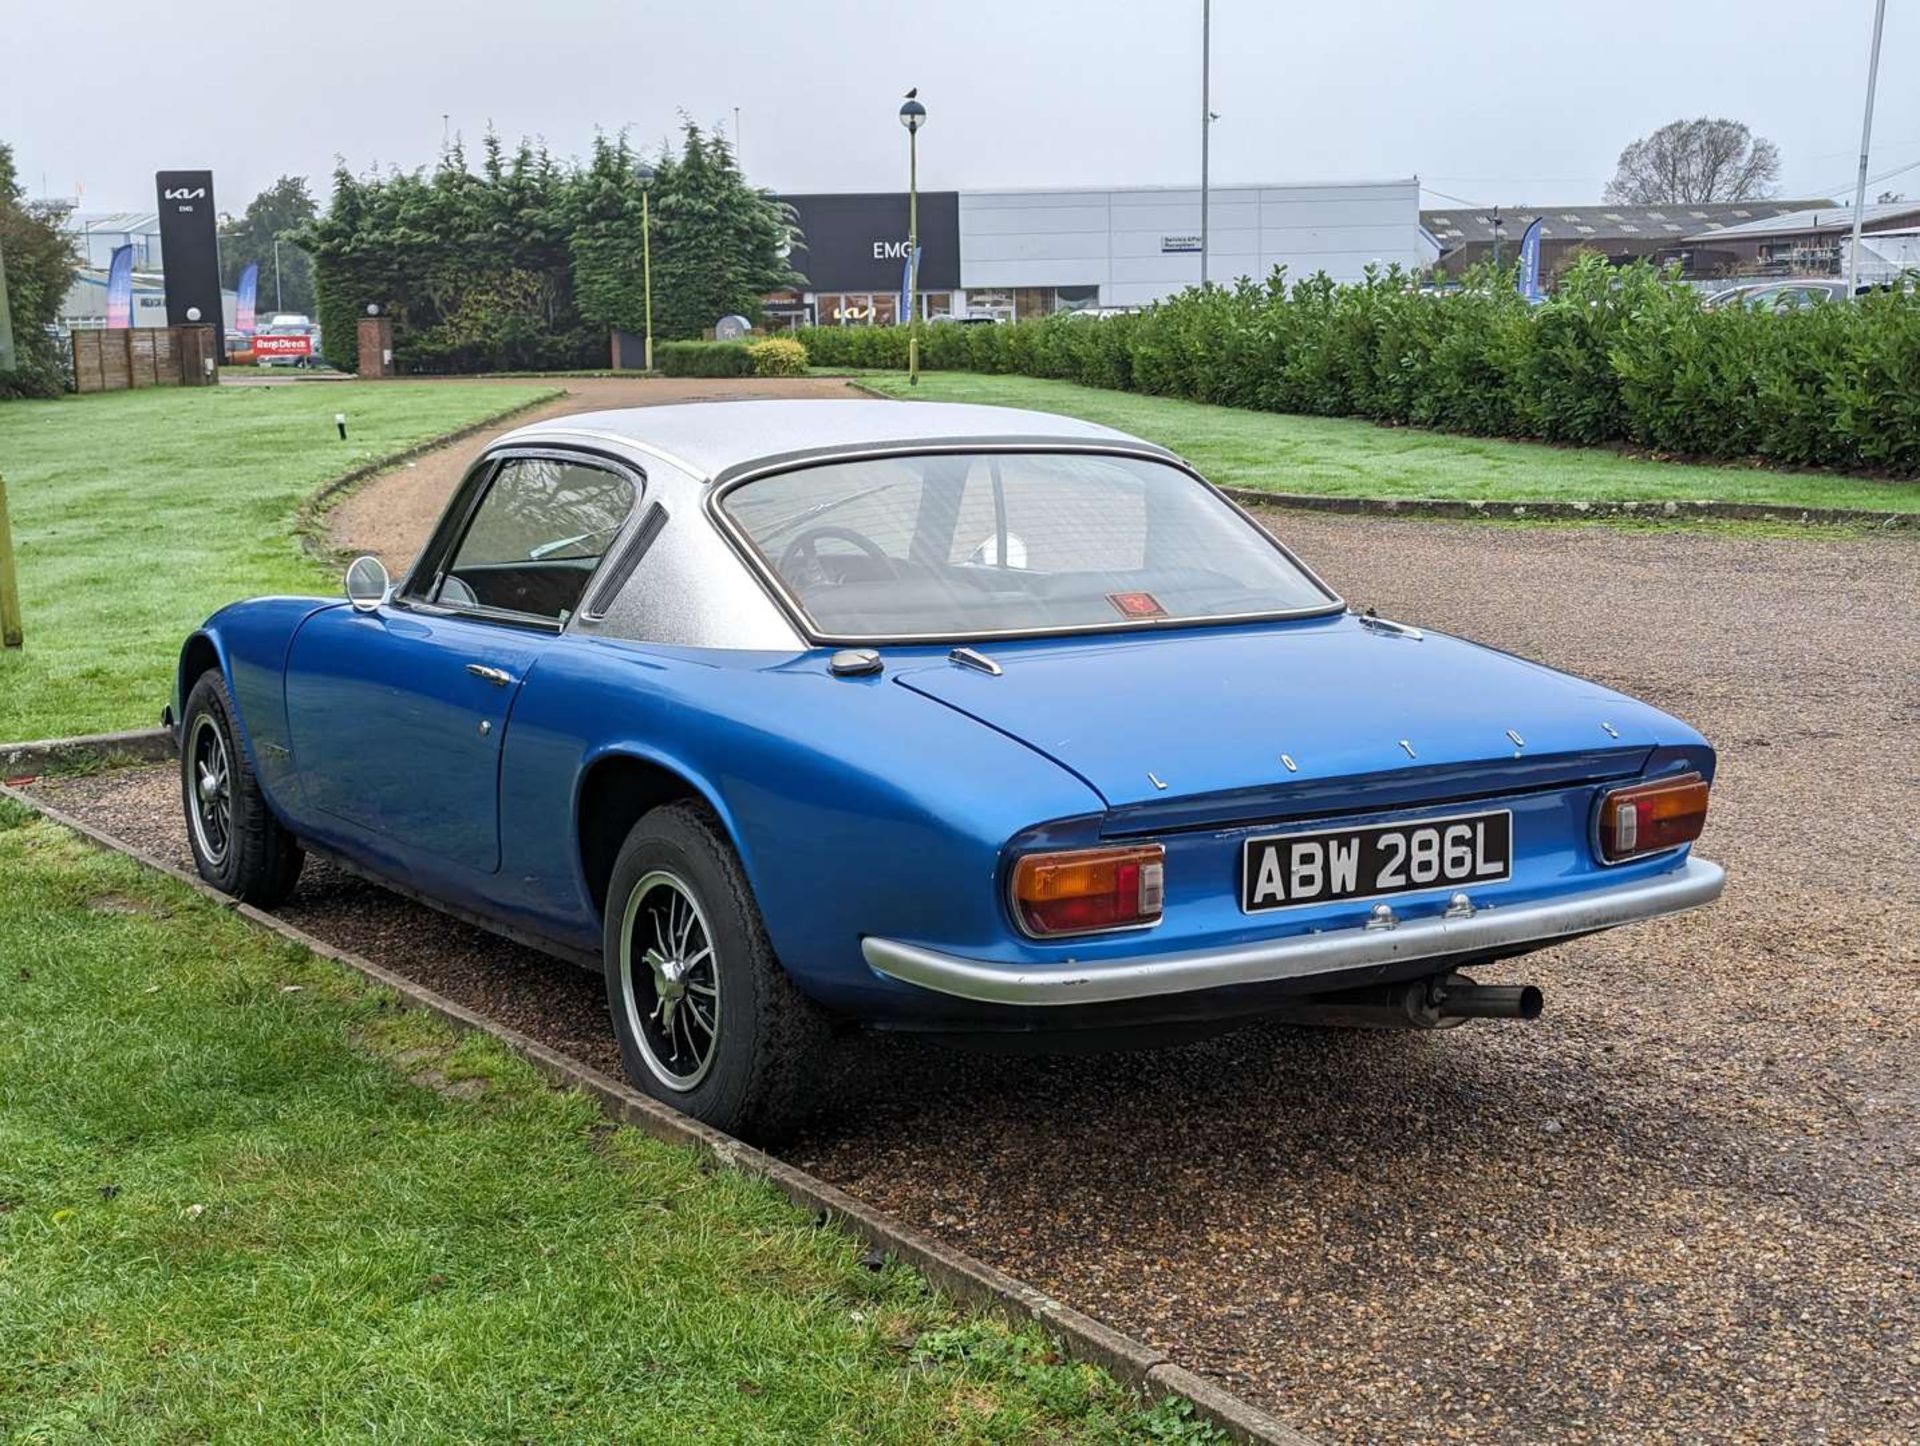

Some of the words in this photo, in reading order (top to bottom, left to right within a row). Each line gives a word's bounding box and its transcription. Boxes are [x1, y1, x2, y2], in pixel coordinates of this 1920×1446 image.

[873, 242, 913, 258] EMG
[1253, 838, 1359, 903] ABW
[1376, 822, 1504, 889] 286L
